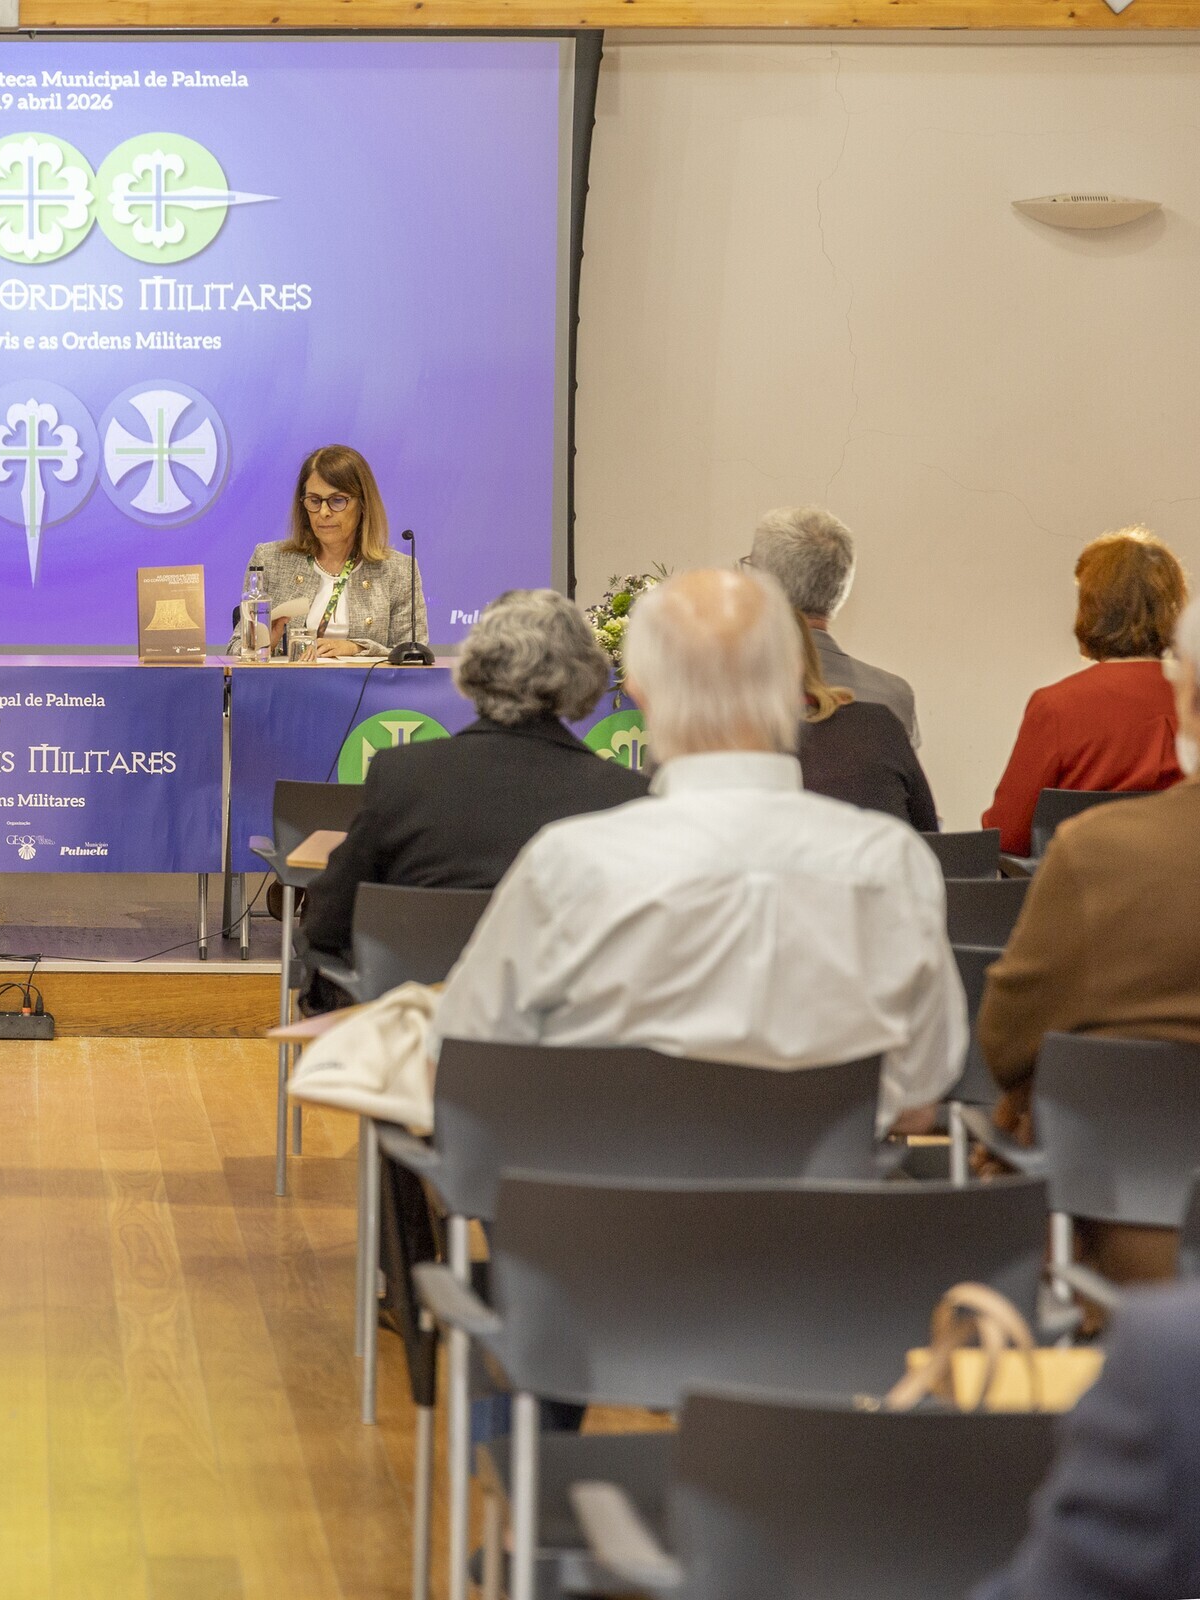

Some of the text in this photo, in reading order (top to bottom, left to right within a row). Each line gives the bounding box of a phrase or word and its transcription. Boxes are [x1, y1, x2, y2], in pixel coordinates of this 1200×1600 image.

[41, 70, 141, 91] Municipal
[144, 70, 168, 88] de
[171, 70, 249, 88] Palmela
[17, 92, 63, 110] abril
[66, 93, 114, 111] 2026
[139, 275, 312, 312] MILITARES
[23, 336, 35, 349] e
[38, 335, 58, 350] as
[62, 331, 132, 350] Ordens
[135, 331, 222, 350] Militares
[24, 692, 43, 707] de
[45, 693, 106, 707] Palmela
[28, 743, 177, 775] MILITARES
[17, 793, 86, 808] Militares
[60, 846, 109, 856] Palmela
